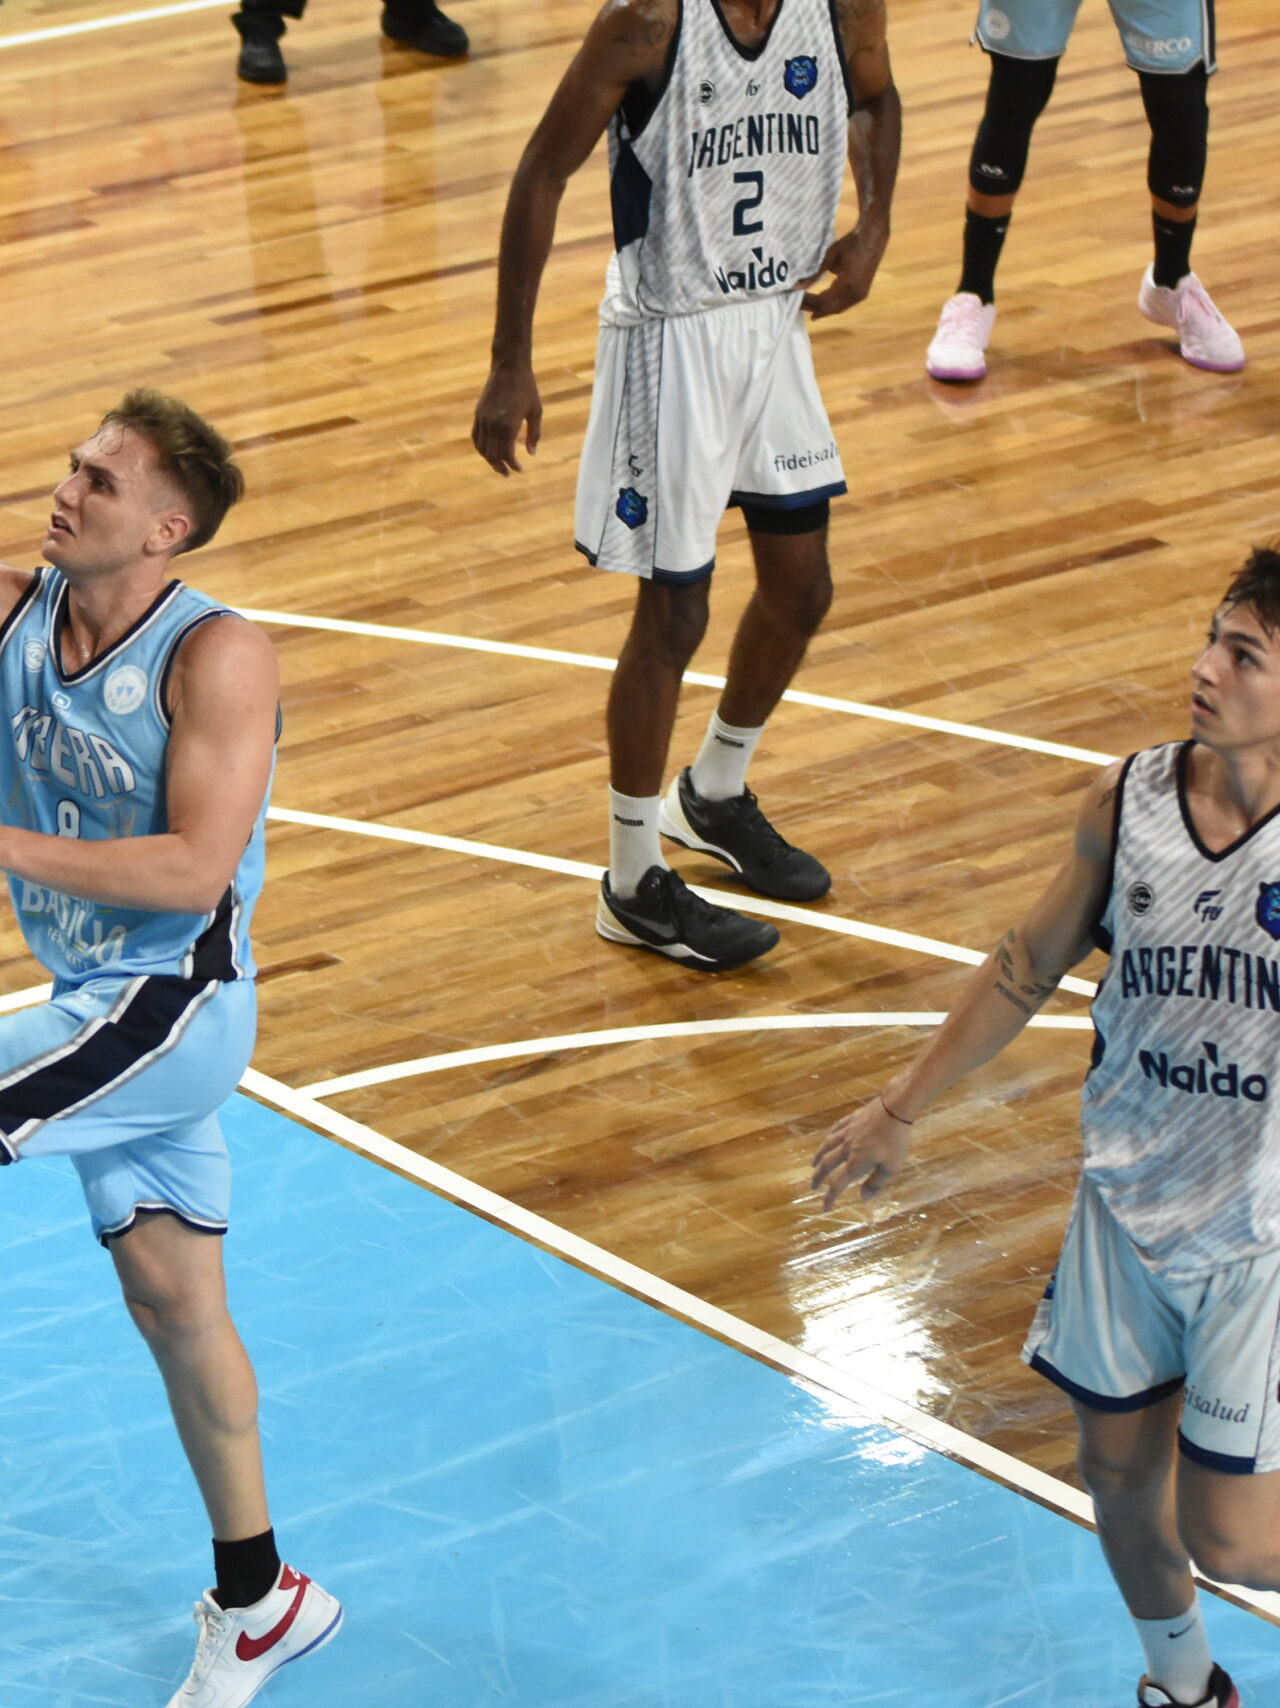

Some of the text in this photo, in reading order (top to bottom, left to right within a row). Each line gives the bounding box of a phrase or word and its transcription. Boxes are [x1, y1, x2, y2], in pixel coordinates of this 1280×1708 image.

[732, 170, 764, 236] 2
[774, 442, 838, 472] fideisal
[1139, 1048, 1268, 1102] Naldo
